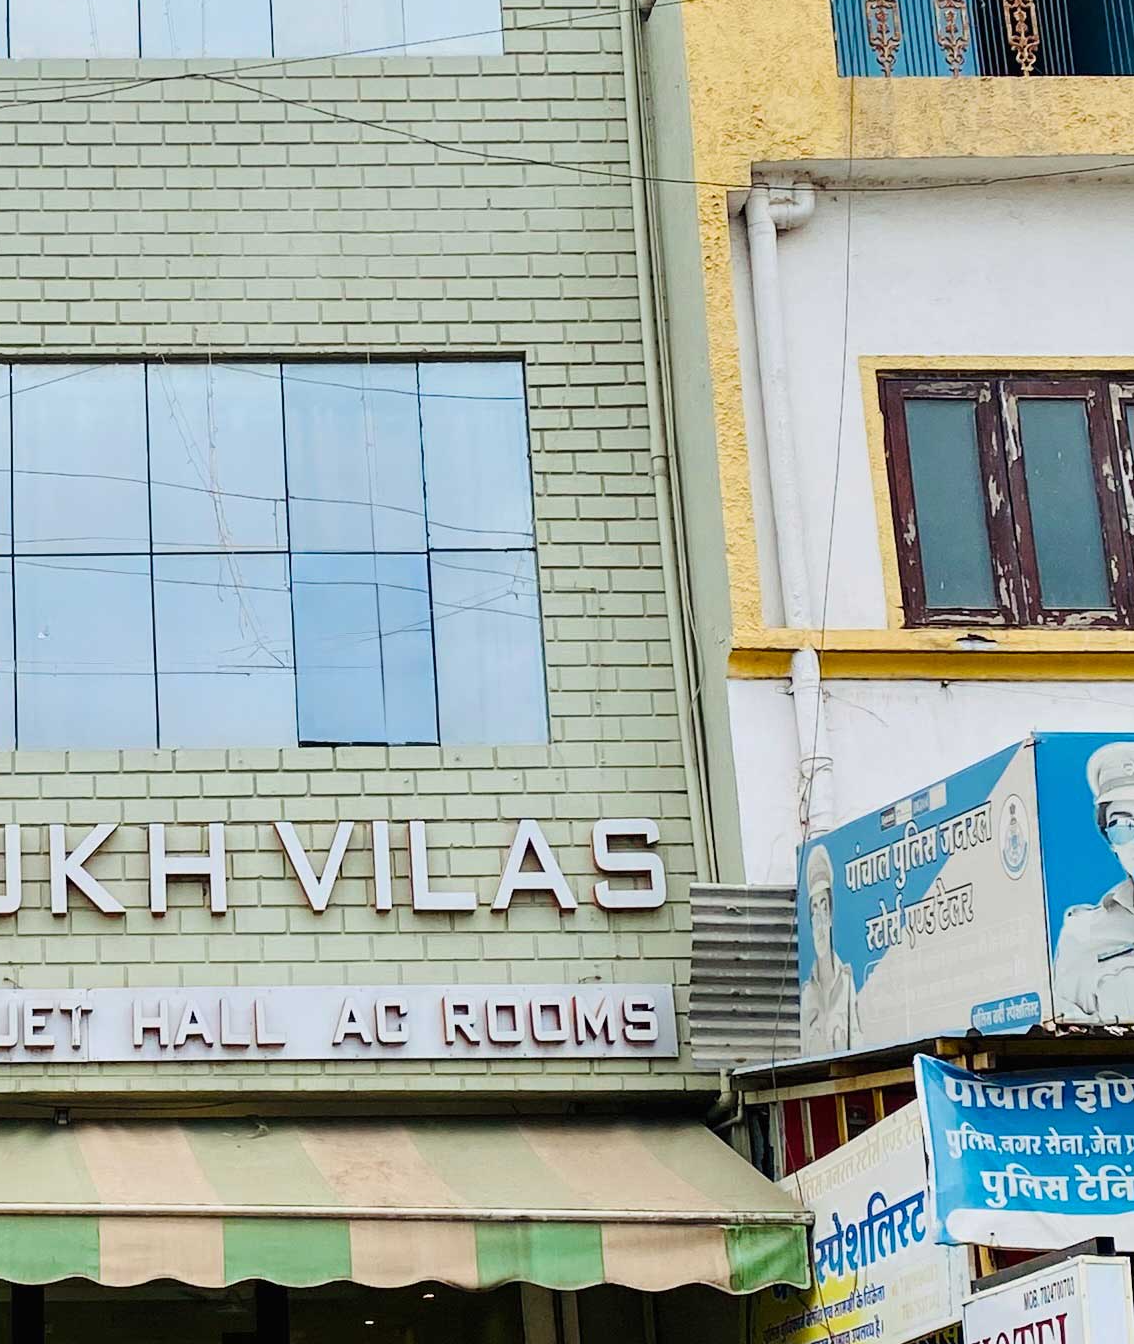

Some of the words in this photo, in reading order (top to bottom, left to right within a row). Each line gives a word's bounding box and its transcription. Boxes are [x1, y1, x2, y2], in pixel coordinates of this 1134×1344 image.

[274, 817, 667, 913] VILAS
[892, 819, 938, 890] पुलिस
[939, 800, 992, 856] जनरल
[131, 996, 287, 1048] HALL
[331, 996, 409, 1044] AC
[442, 994, 660, 1045] ROOMS
[979, 1162, 1070, 1208] पुलिस
[814, 1191, 926, 1284] स्पेशलिस्ट
